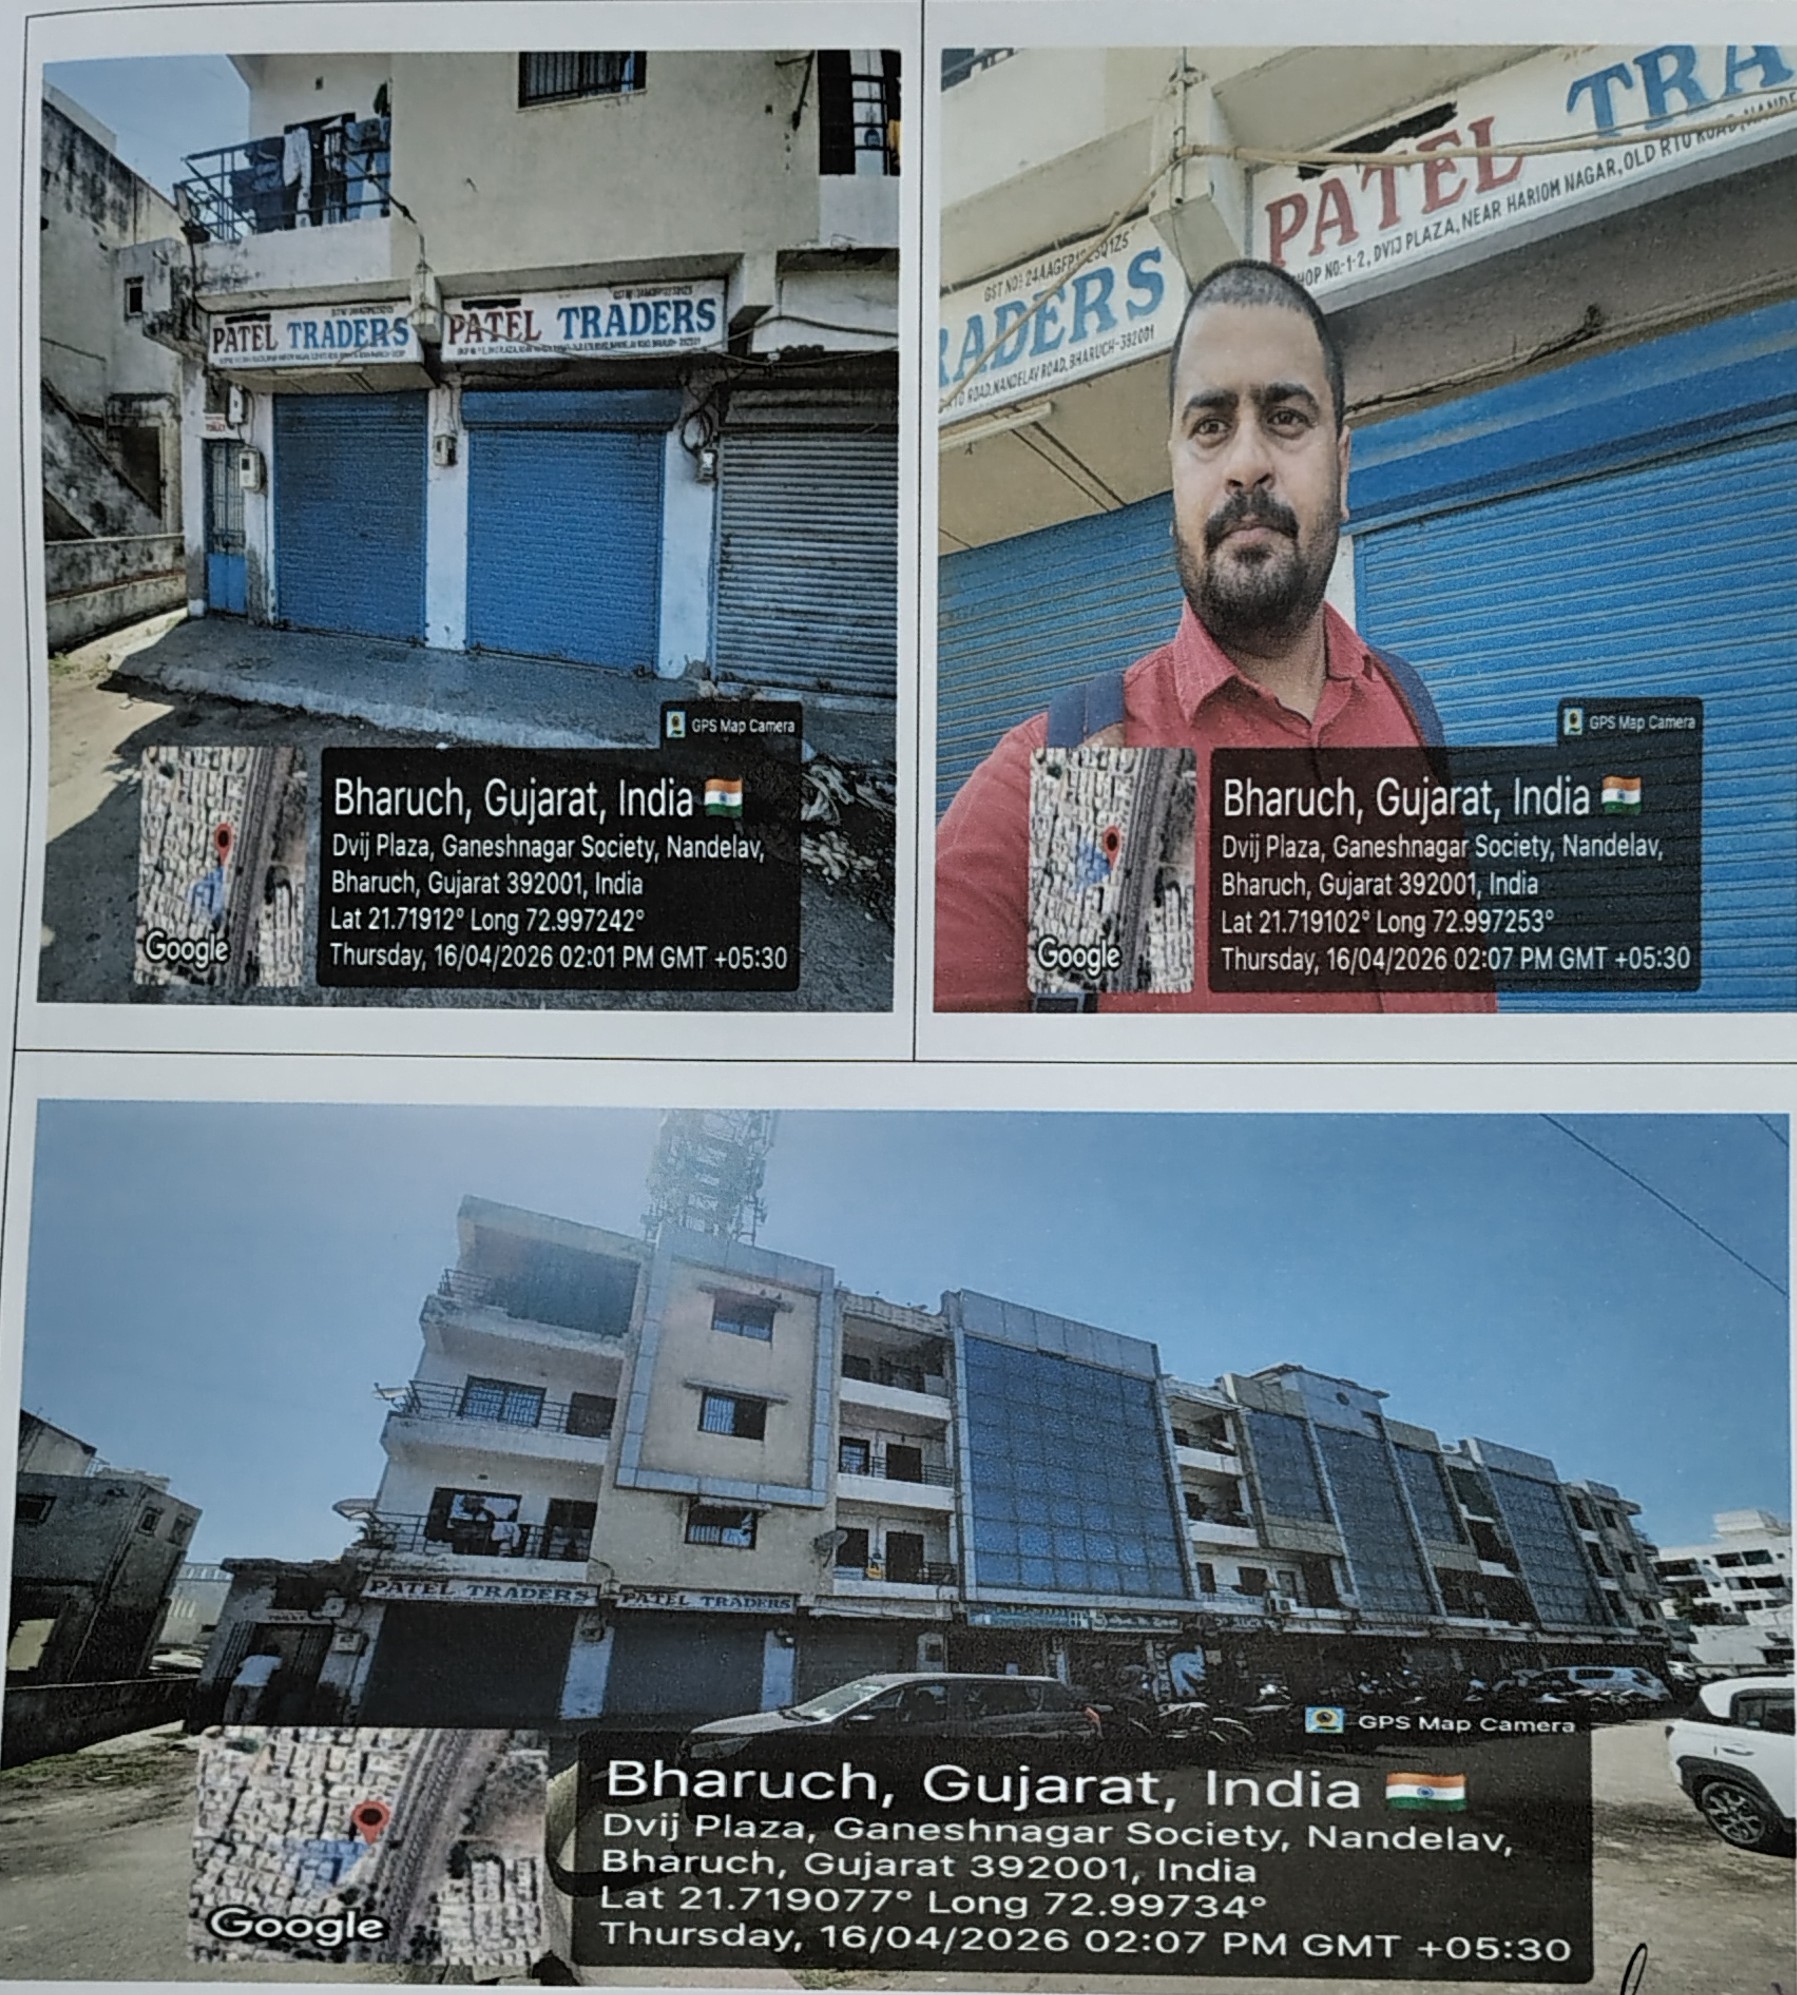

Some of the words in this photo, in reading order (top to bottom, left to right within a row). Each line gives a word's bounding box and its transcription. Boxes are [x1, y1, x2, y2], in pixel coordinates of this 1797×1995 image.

[1265, 115, 1524, 269] PATEL
[1296, 262, 1322, 288] HOP
[1405, 217, 1460, 251] PLAZA,
[1462, 200, 1500, 229] NEAR
[1507, 179, 1561, 213] HARIOM
[1564, 158, 1623, 194] NAGAR,
[1624, 142, 1656, 171] OLD
[984, 281, 1003, 302] GST
[212, 324, 279, 354] PATEL
[287, 317, 409, 349] TRADERS
[449, 309, 542, 345] PATEL
[558, 298, 716, 341] TRADERS
[938, 246, 1164, 388] ADERS
[370, 1579, 456, 1597] PATEL
[467, 1584, 591, 1601] TRADERS
[622, 1592, 690, 1606] PATEL
[702, 1596, 792, 1610] TRADERS
